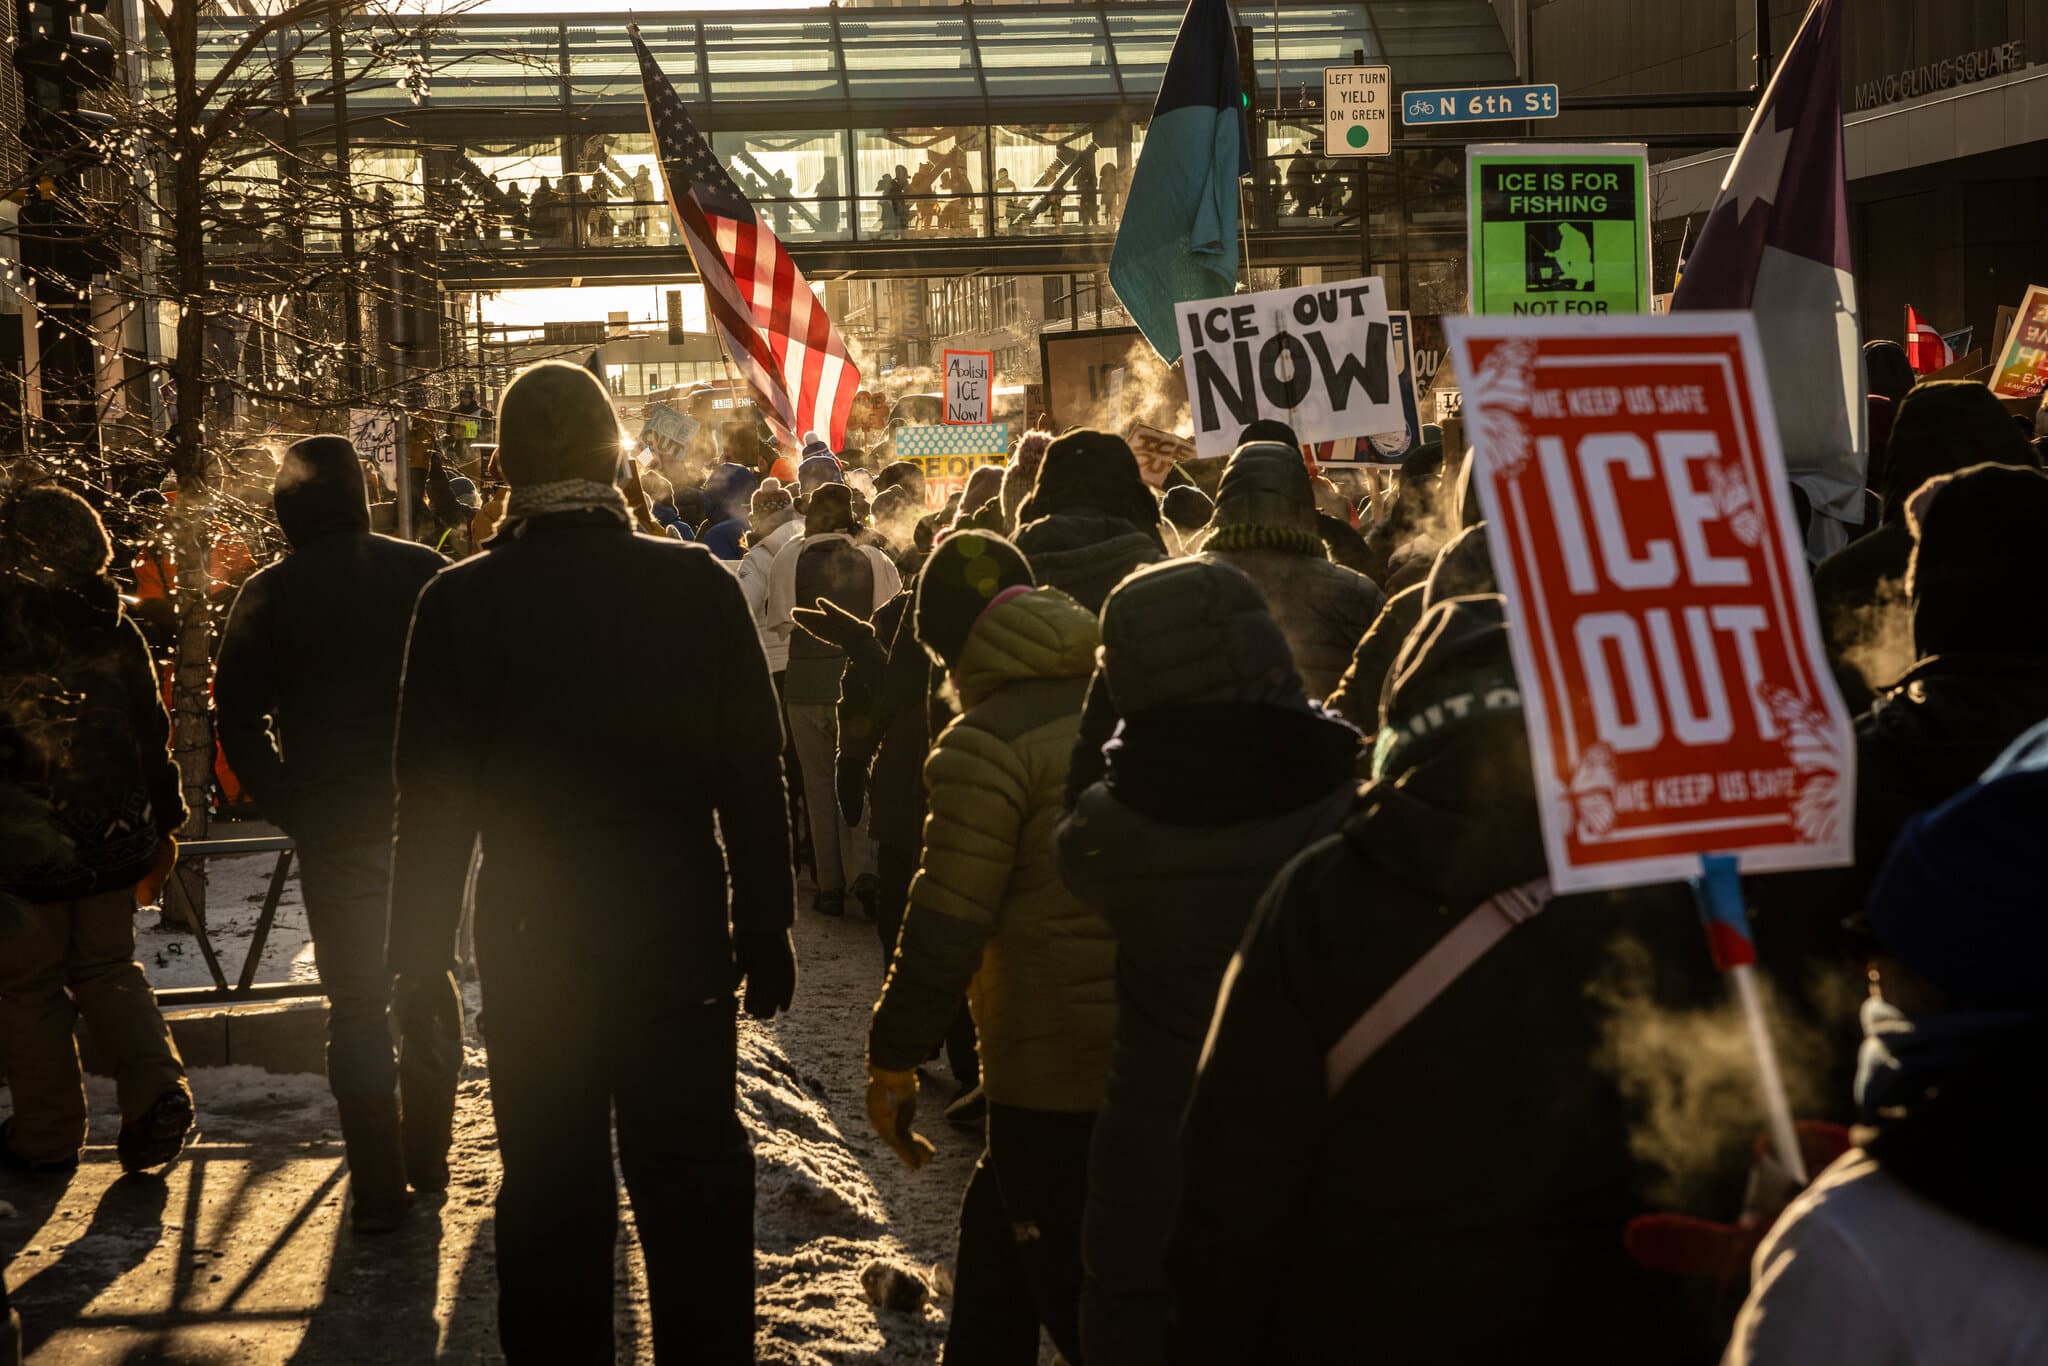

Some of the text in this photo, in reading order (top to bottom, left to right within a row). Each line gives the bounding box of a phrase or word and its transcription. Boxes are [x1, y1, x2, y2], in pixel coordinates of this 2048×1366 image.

[1329, 73, 1386, 85] LEFT TURN
[1855, 40, 2022, 110] MAYO CLINIC SQUARE
[1340, 90, 1375, 104] YIELD
[1440, 92, 1552, 116] N 6th St
[1330, 109, 1385, 121] ON GREEN
[1497, 172, 1619, 192] ICE IS FOR
[1509, 195, 1608, 215] FISHING
[1187, 285, 1370, 348] ICE OUT
[1513, 300, 1608, 316] NOT FOR
[947, 359, 988, 380] Abolish
[1192, 321, 1390, 433] NOW
[956, 380, 980, 401] ICE
[1532, 383, 1710, 419] WE KEEP US SAFE
[948, 402, 984, 423] Now!
[1535, 430, 1753, 596] ICE
[1572, 604, 1779, 755] OUT
[1653, 773, 1716, 809] KEEP
[1718, 769, 1750, 802] US
[1750, 767, 1799, 799] SAFE
